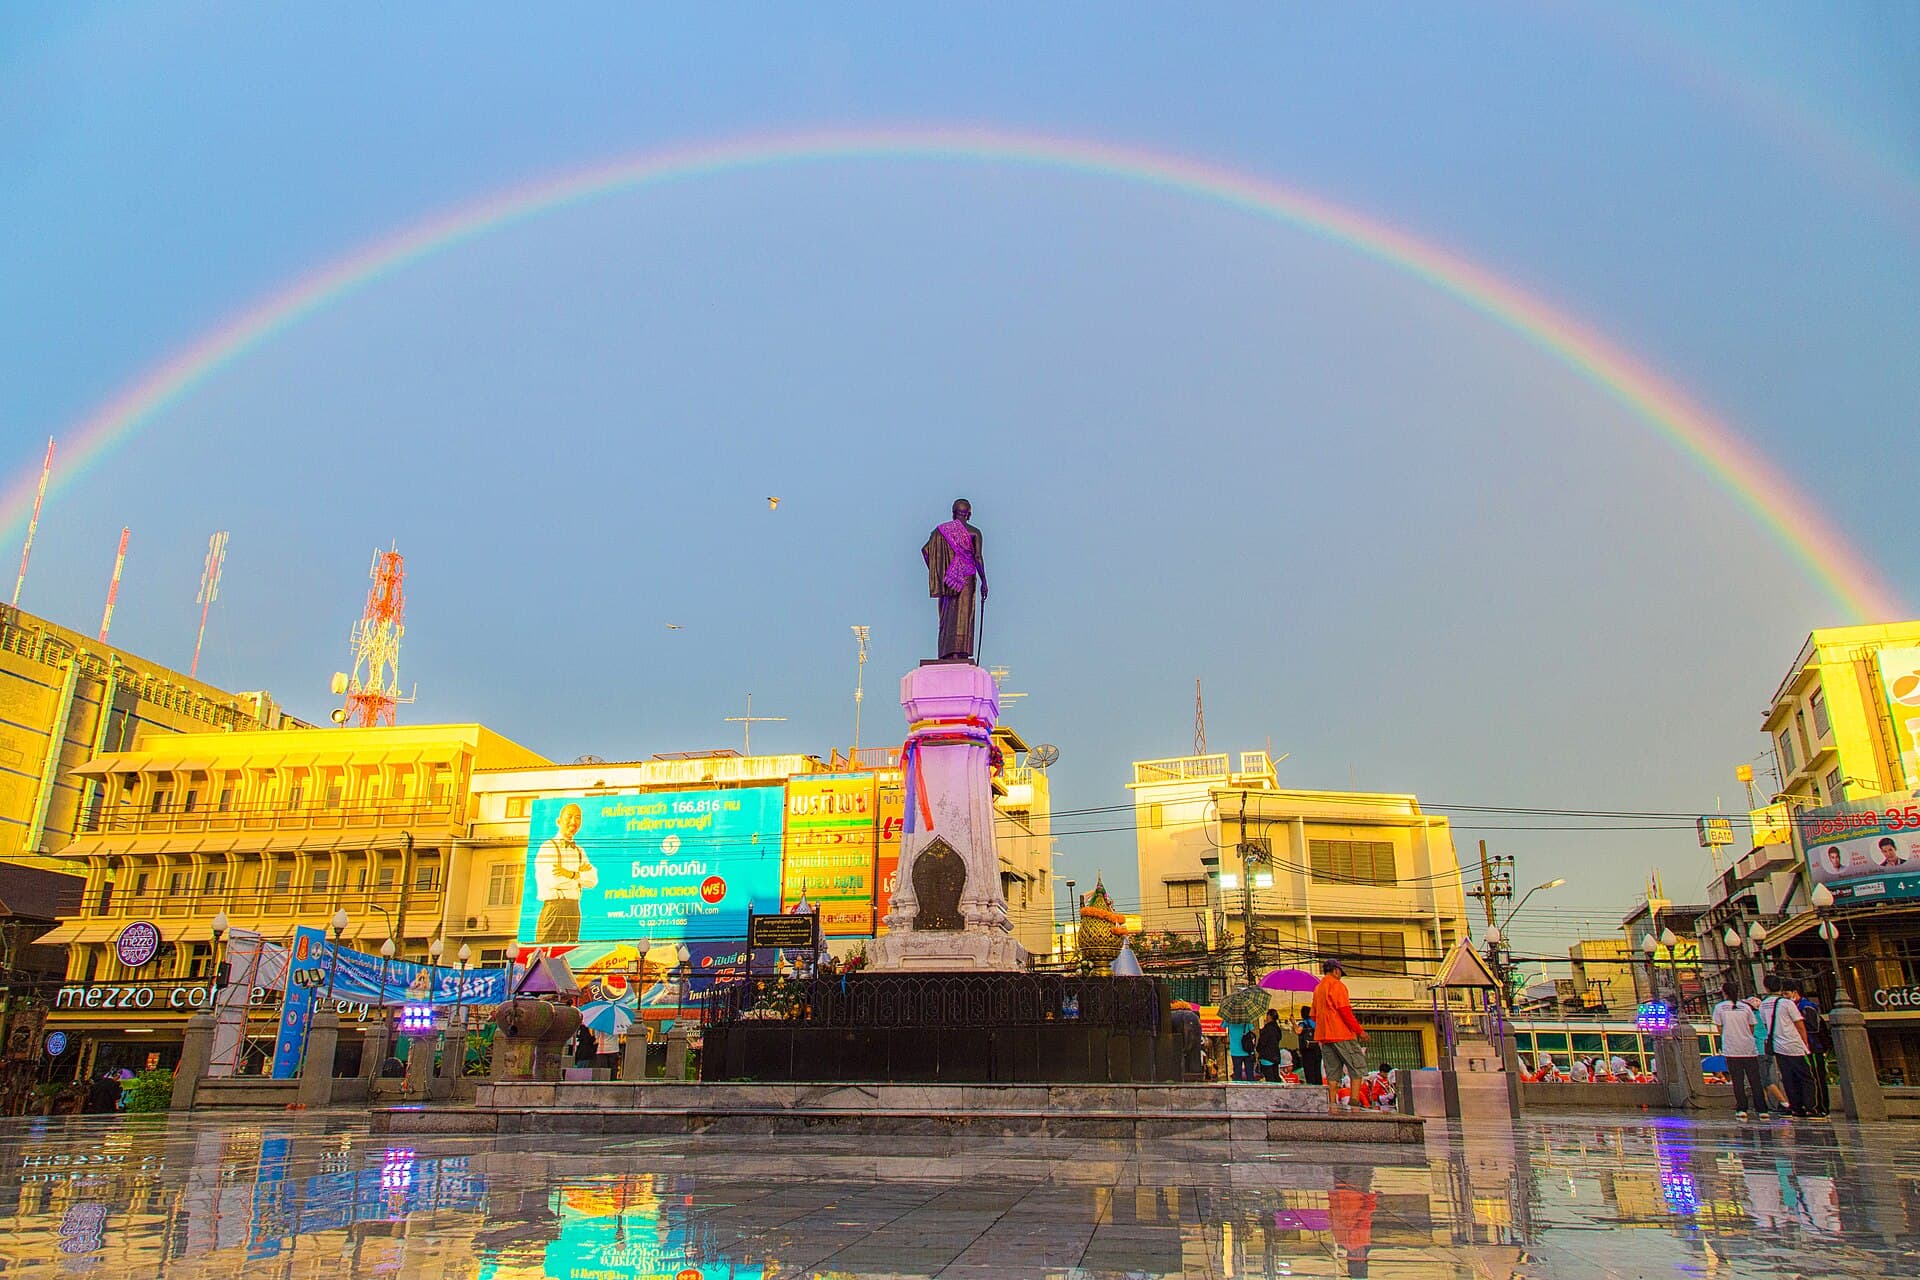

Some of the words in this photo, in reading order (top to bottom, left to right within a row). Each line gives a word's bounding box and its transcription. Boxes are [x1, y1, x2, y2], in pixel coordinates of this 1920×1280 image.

[672, 800, 720, 813] 166,816
[1710, 830, 1732, 841] BAM
[701, 881, 725, 897] ฟรี!
[121, 937, 154, 947] mezzo
[440, 975, 496, 997] START
[56, 985, 155, 1008] mezzo
[170, 983, 265, 1007] cofe
[1874, 986, 1920, 1006] Café
